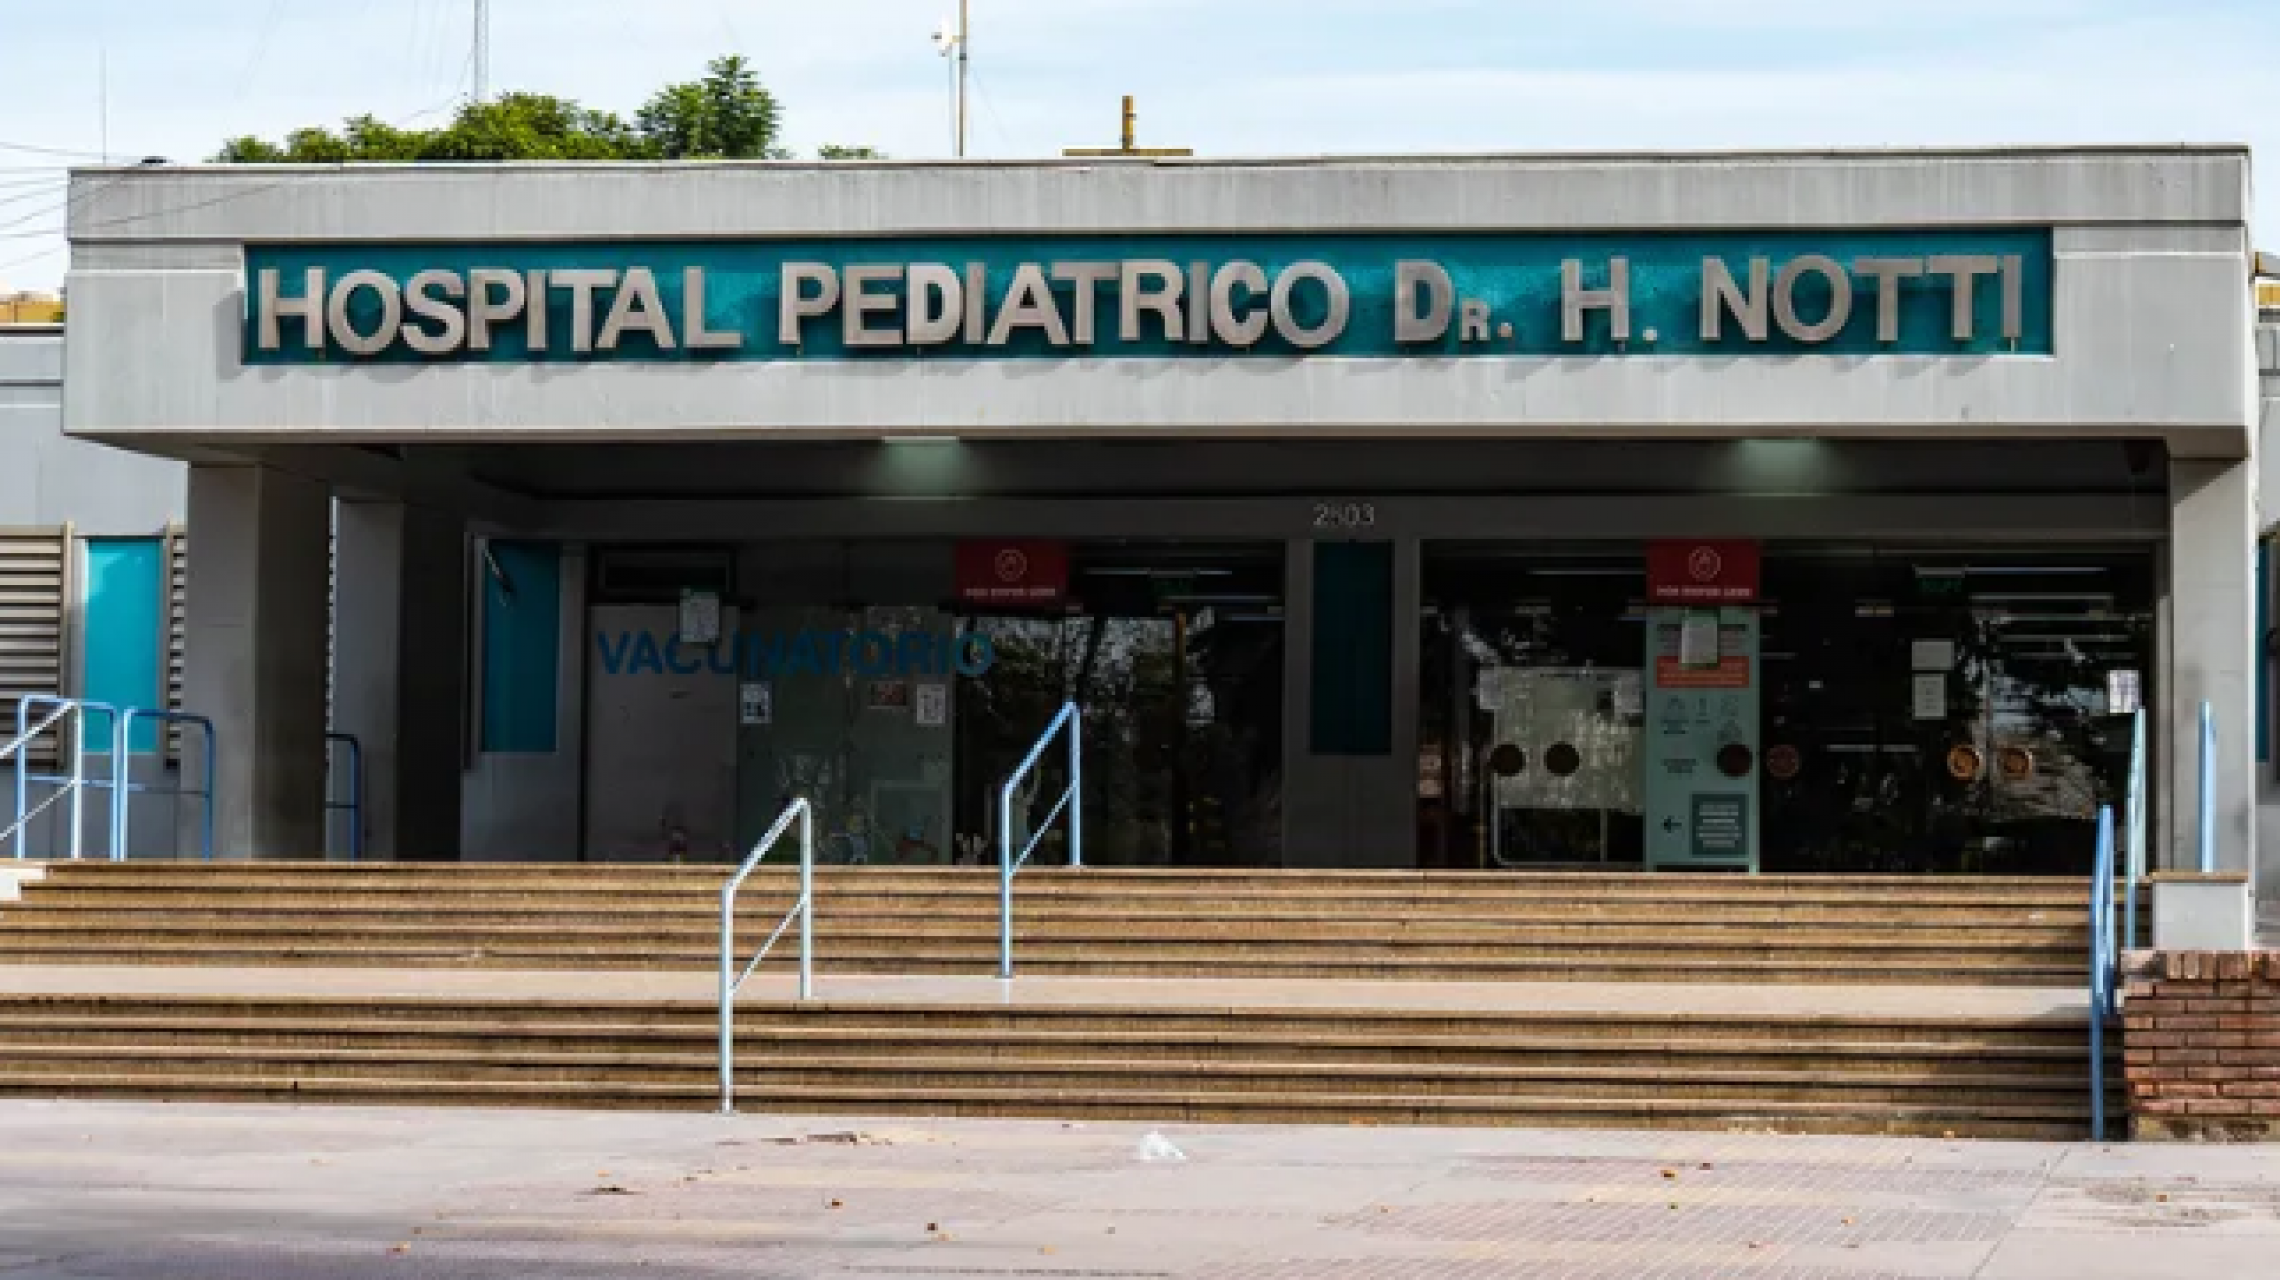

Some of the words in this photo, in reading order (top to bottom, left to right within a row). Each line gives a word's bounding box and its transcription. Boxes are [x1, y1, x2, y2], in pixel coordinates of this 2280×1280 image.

[256, 265, 743, 355] HOSPITAL
[778, 258, 1351, 348] PEDIATRICO
[1559, 257, 1658, 343] H.
[1700, 253, 2023, 343] NOTTI
[597, 629, 996, 677] VACUNATORIO
